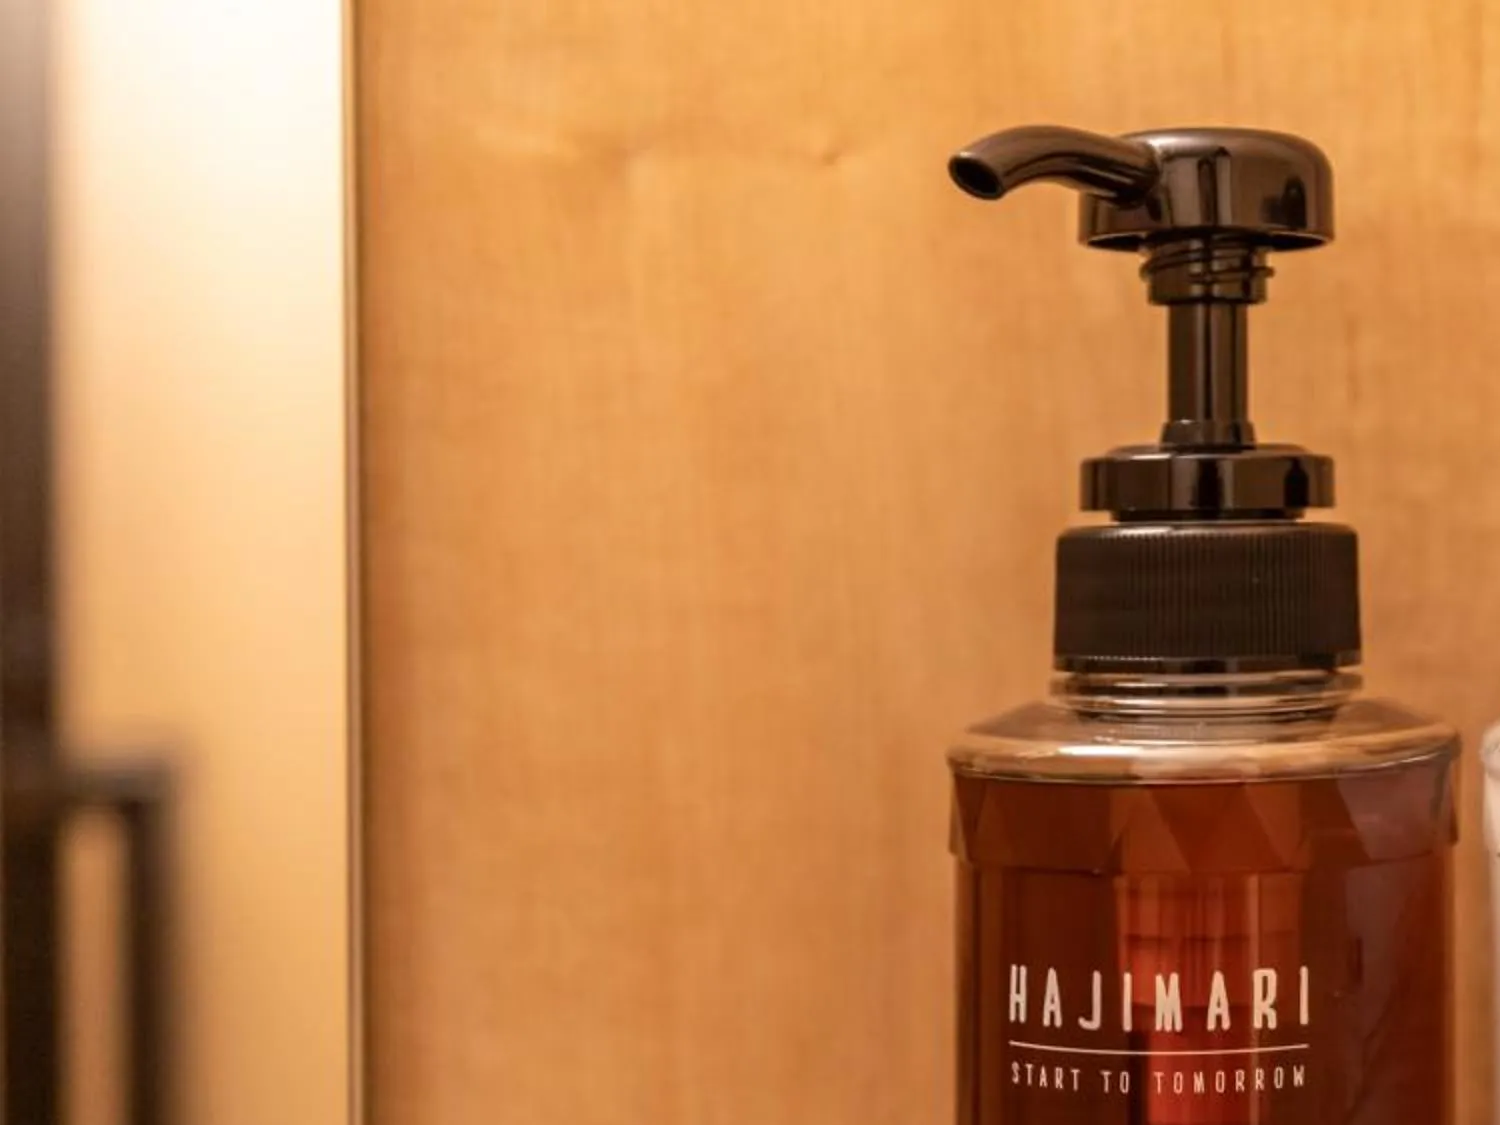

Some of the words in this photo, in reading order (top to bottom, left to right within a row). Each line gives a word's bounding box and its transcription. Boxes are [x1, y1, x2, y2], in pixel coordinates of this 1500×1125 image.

[1009, 964, 1308, 1032] HAJIMARI
[1012, 1061, 1080, 1091] START
[1101, 1071, 1130, 1094] TO
[1154, 1065, 1305, 1095] TOMORROW
